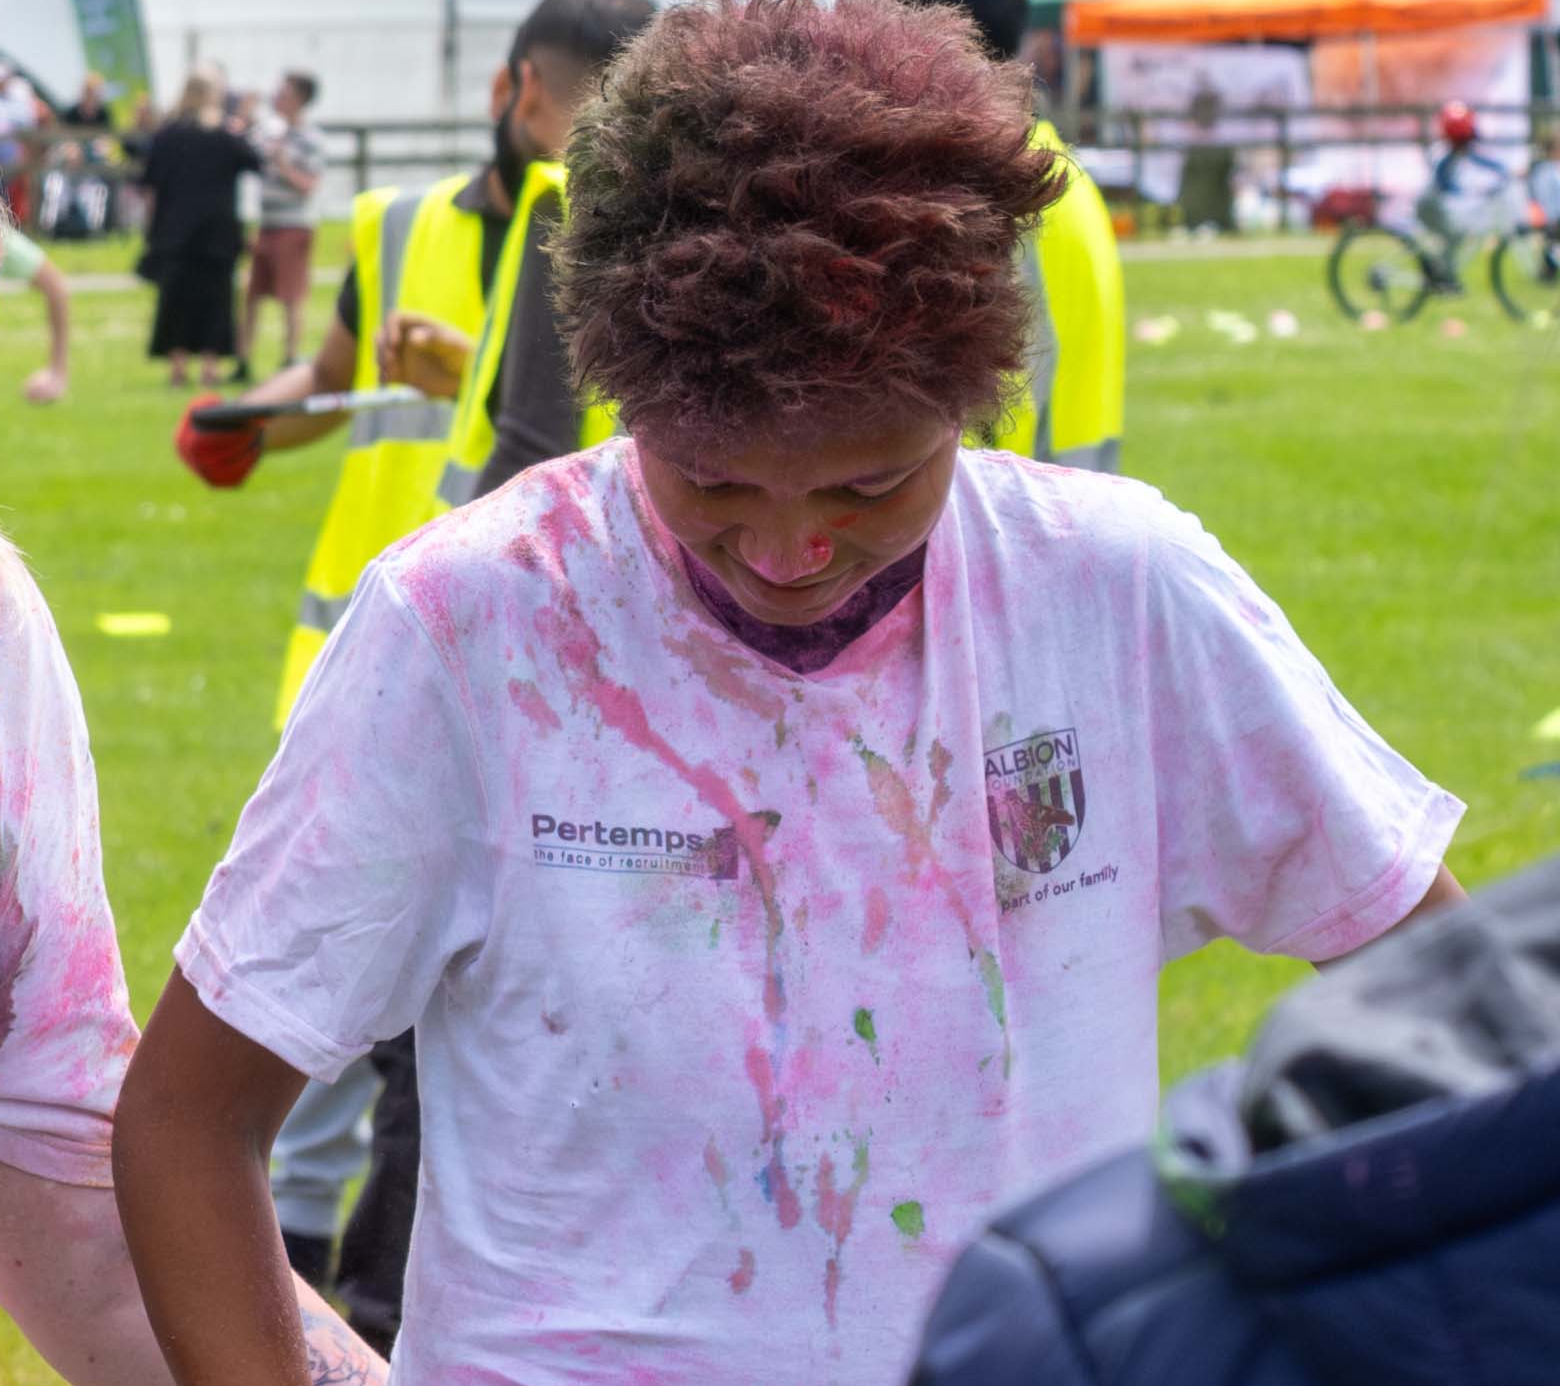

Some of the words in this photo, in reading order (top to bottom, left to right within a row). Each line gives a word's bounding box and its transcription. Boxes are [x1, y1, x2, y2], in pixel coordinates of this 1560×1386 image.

[985, 734, 1073, 780] ALBION
[531, 813, 704, 853] Pertemps
[534, 848, 554, 862] the
[561, 851, 592, 866] face
[599, 855, 613, 867] of
[1035, 883, 1049, 901] of
[1053, 879, 1075, 896] our
[1080, 863, 1119, 888] family
